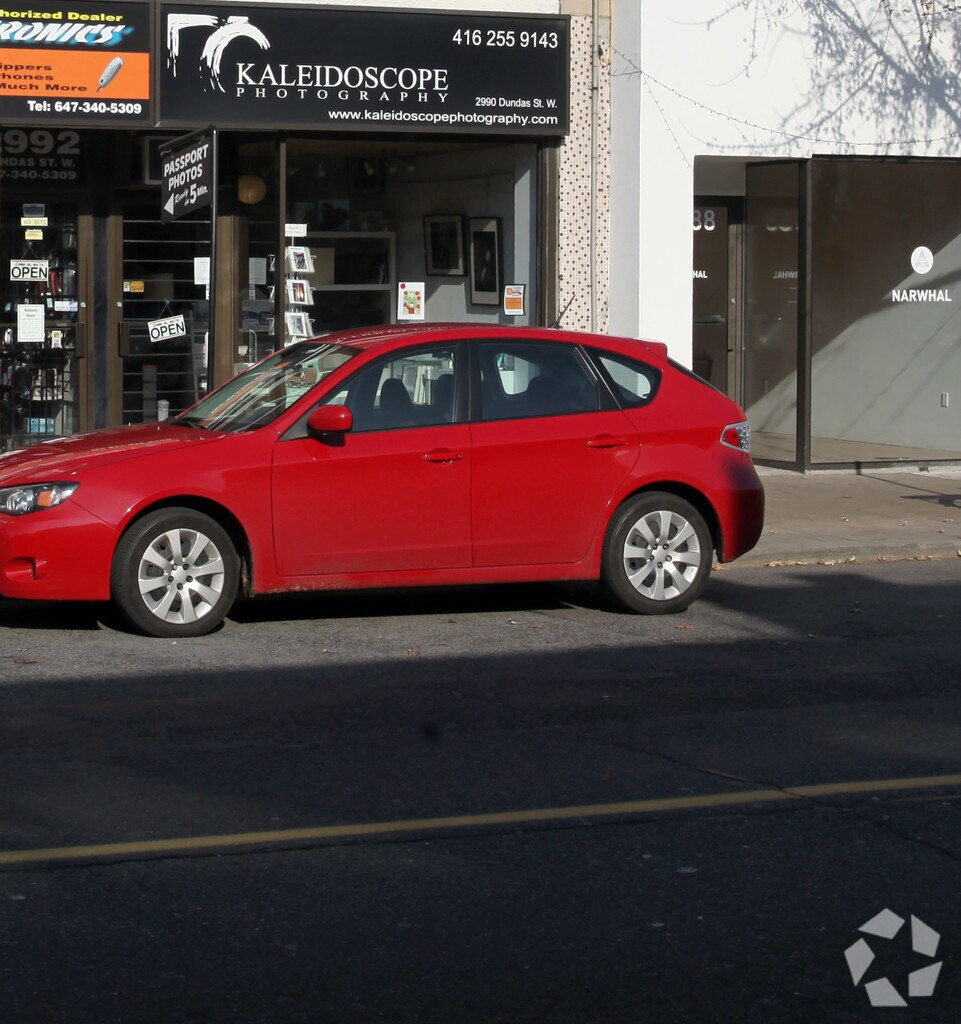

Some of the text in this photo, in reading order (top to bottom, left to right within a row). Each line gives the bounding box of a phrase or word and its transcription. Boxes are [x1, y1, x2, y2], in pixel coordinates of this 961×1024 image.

[68, 10, 123, 22] Dealer
[452, 29, 558, 48] 416 255 9143
[236, 63, 449, 91] KALEIDOSCOPE
[45, 84, 88, 92] More
[236, 88, 448, 103] PHOTOGRAPHY
[27, 100, 142, 114] Tel: 647-340-5309
[475, 97, 558, 108] 2990 Dundas St. W.
[328, 110, 558, 126] www.kaleidoscopephotography.com
[0, 129, 80, 154] 992
[40, 158, 57, 167] ST.
[61, 158, 76, 167] W.
[164, 144, 209, 177] PASSPORT
[168, 163, 203, 191] PHOTOS
[190, 183, 197, 204] 5
[197, 185, 208, 197] Min.
[11, 267, 48, 278] OPEN
[892, 289, 952, 302] NARWHAL
[151, 322, 185, 339] OPEN
